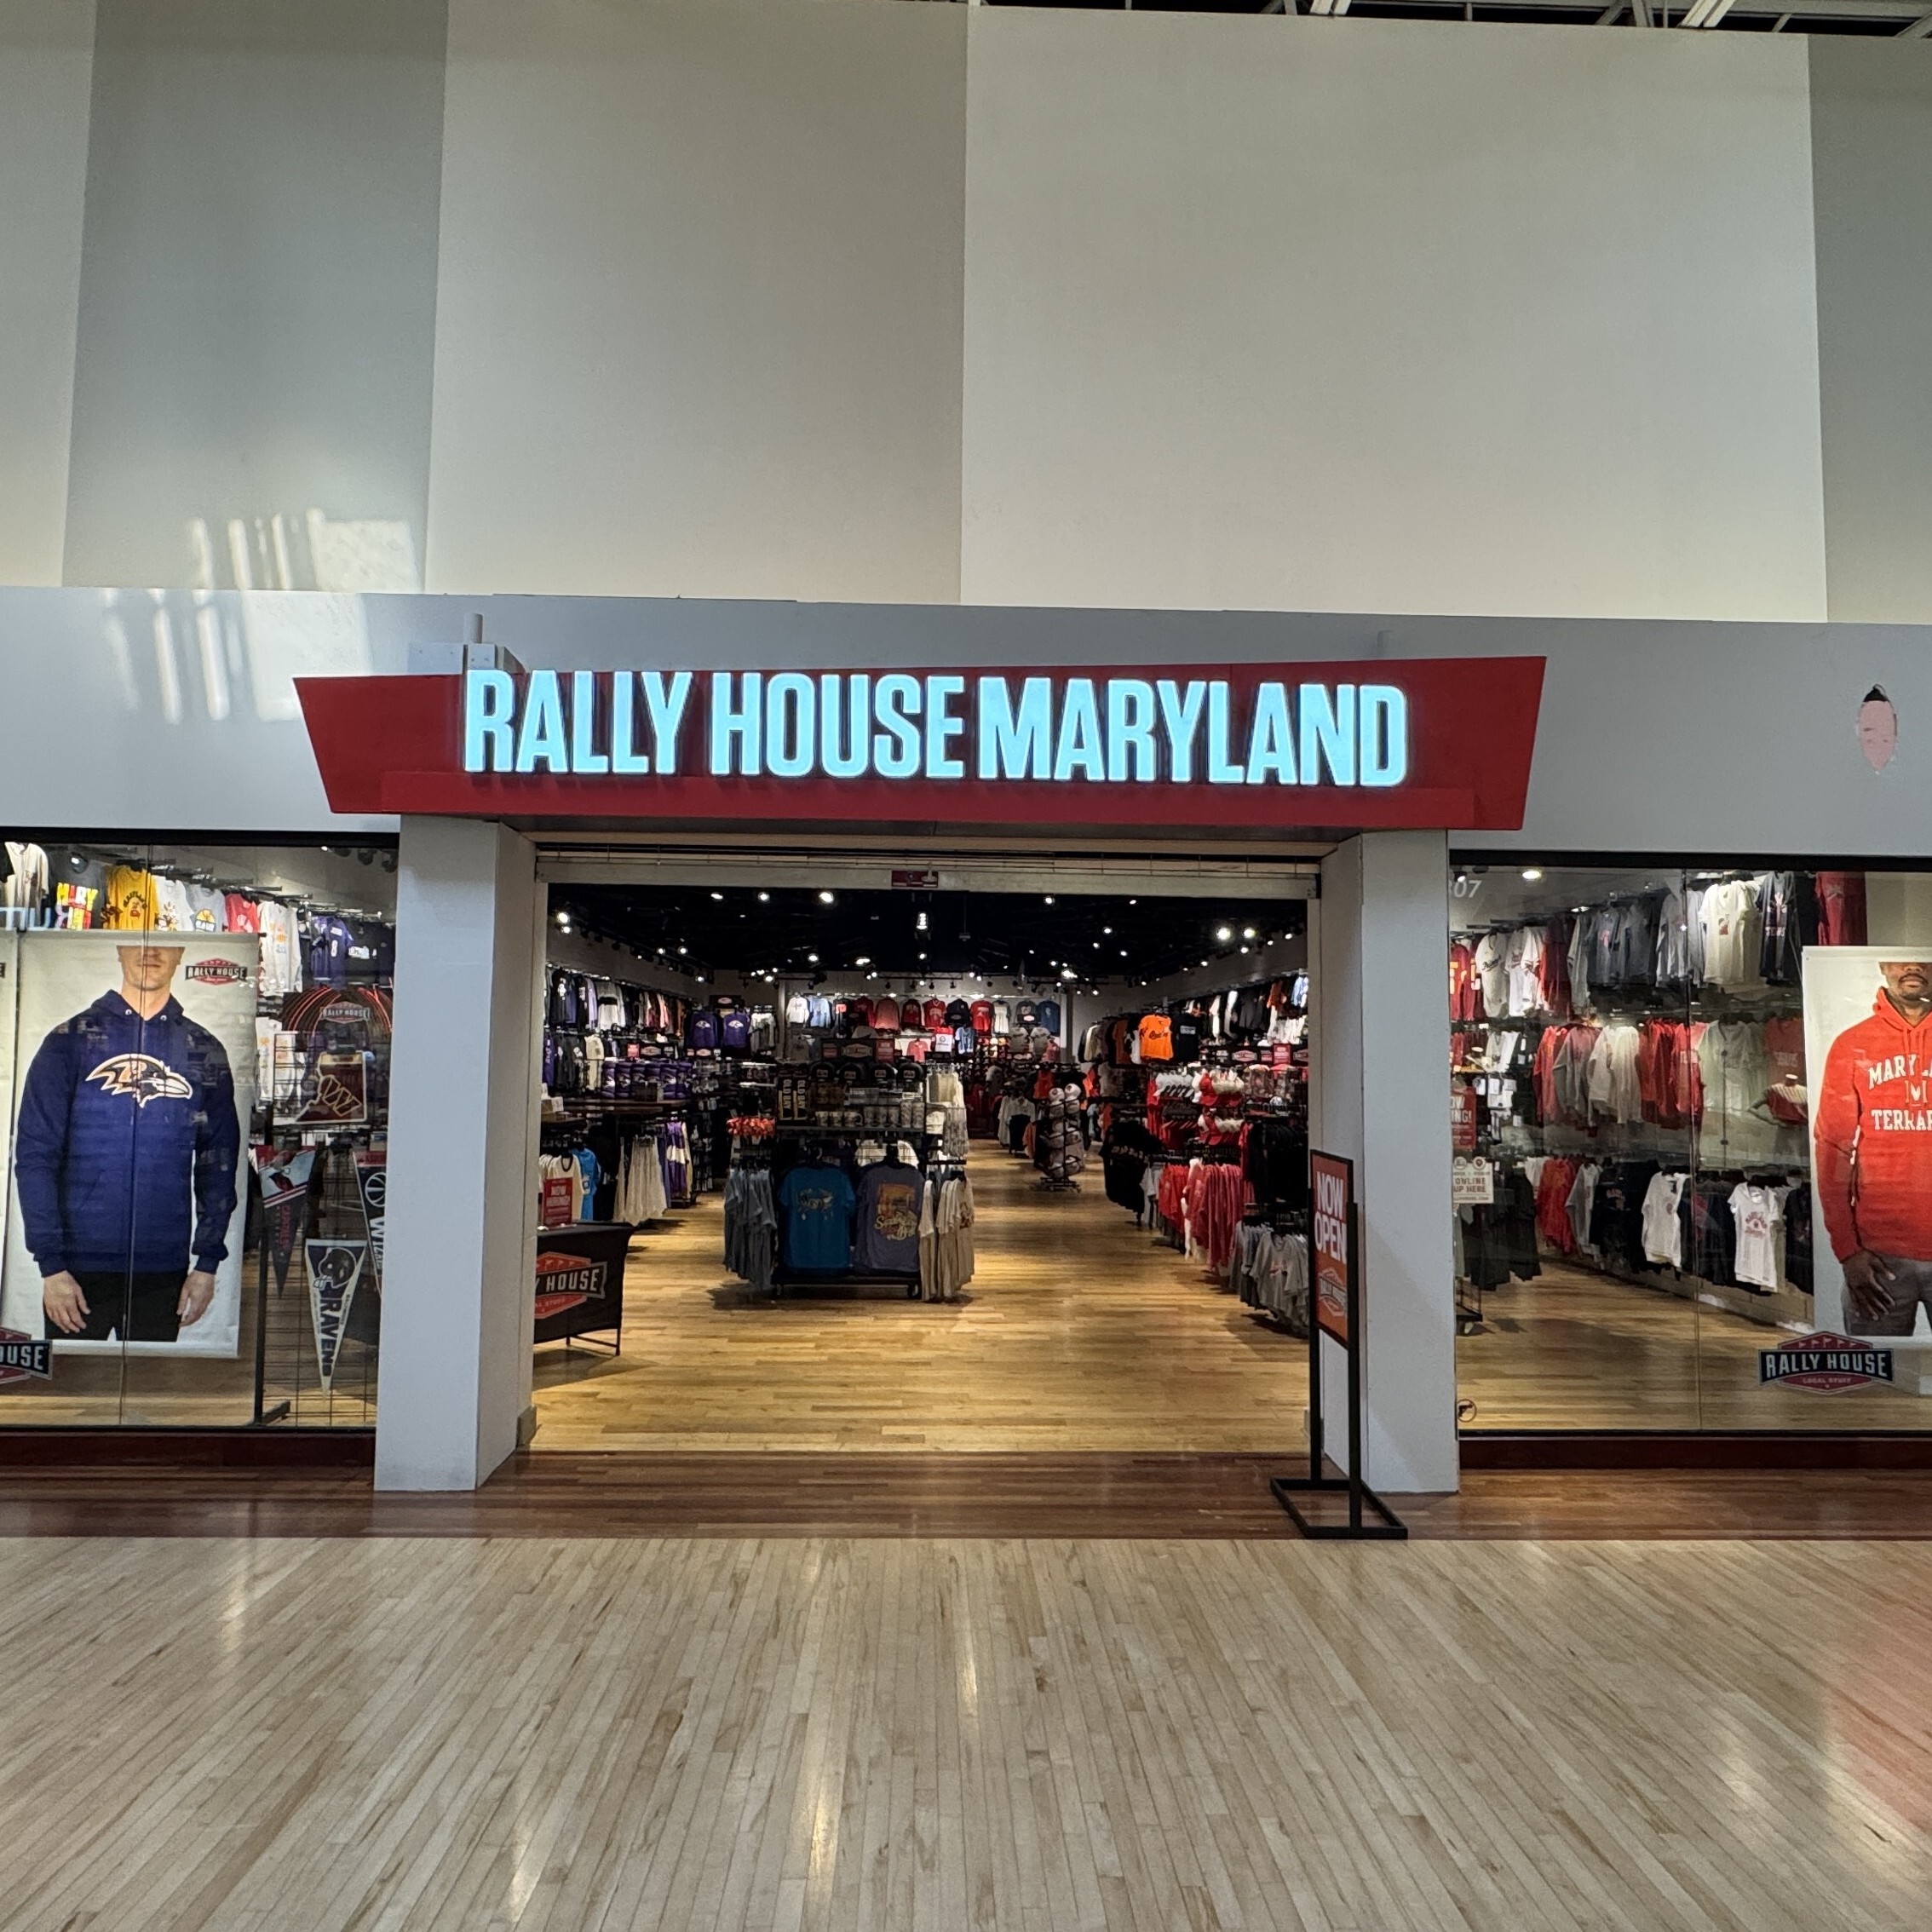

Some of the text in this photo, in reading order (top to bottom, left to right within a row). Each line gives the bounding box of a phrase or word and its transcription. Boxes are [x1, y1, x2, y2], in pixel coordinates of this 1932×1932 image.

[464, 670, 1407, 787] RALLY HOUSE MARYLAND
[188, 967, 245, 979] RALLY HOUSE
[1316, 1171, 1343, 1220] NOW
[1314, 1211, 1348, 1264] OPEN
[546, 1268, 600, 1292] HOUSE
[1766, 1353, 1889, 1378] RALLY HOUSE
